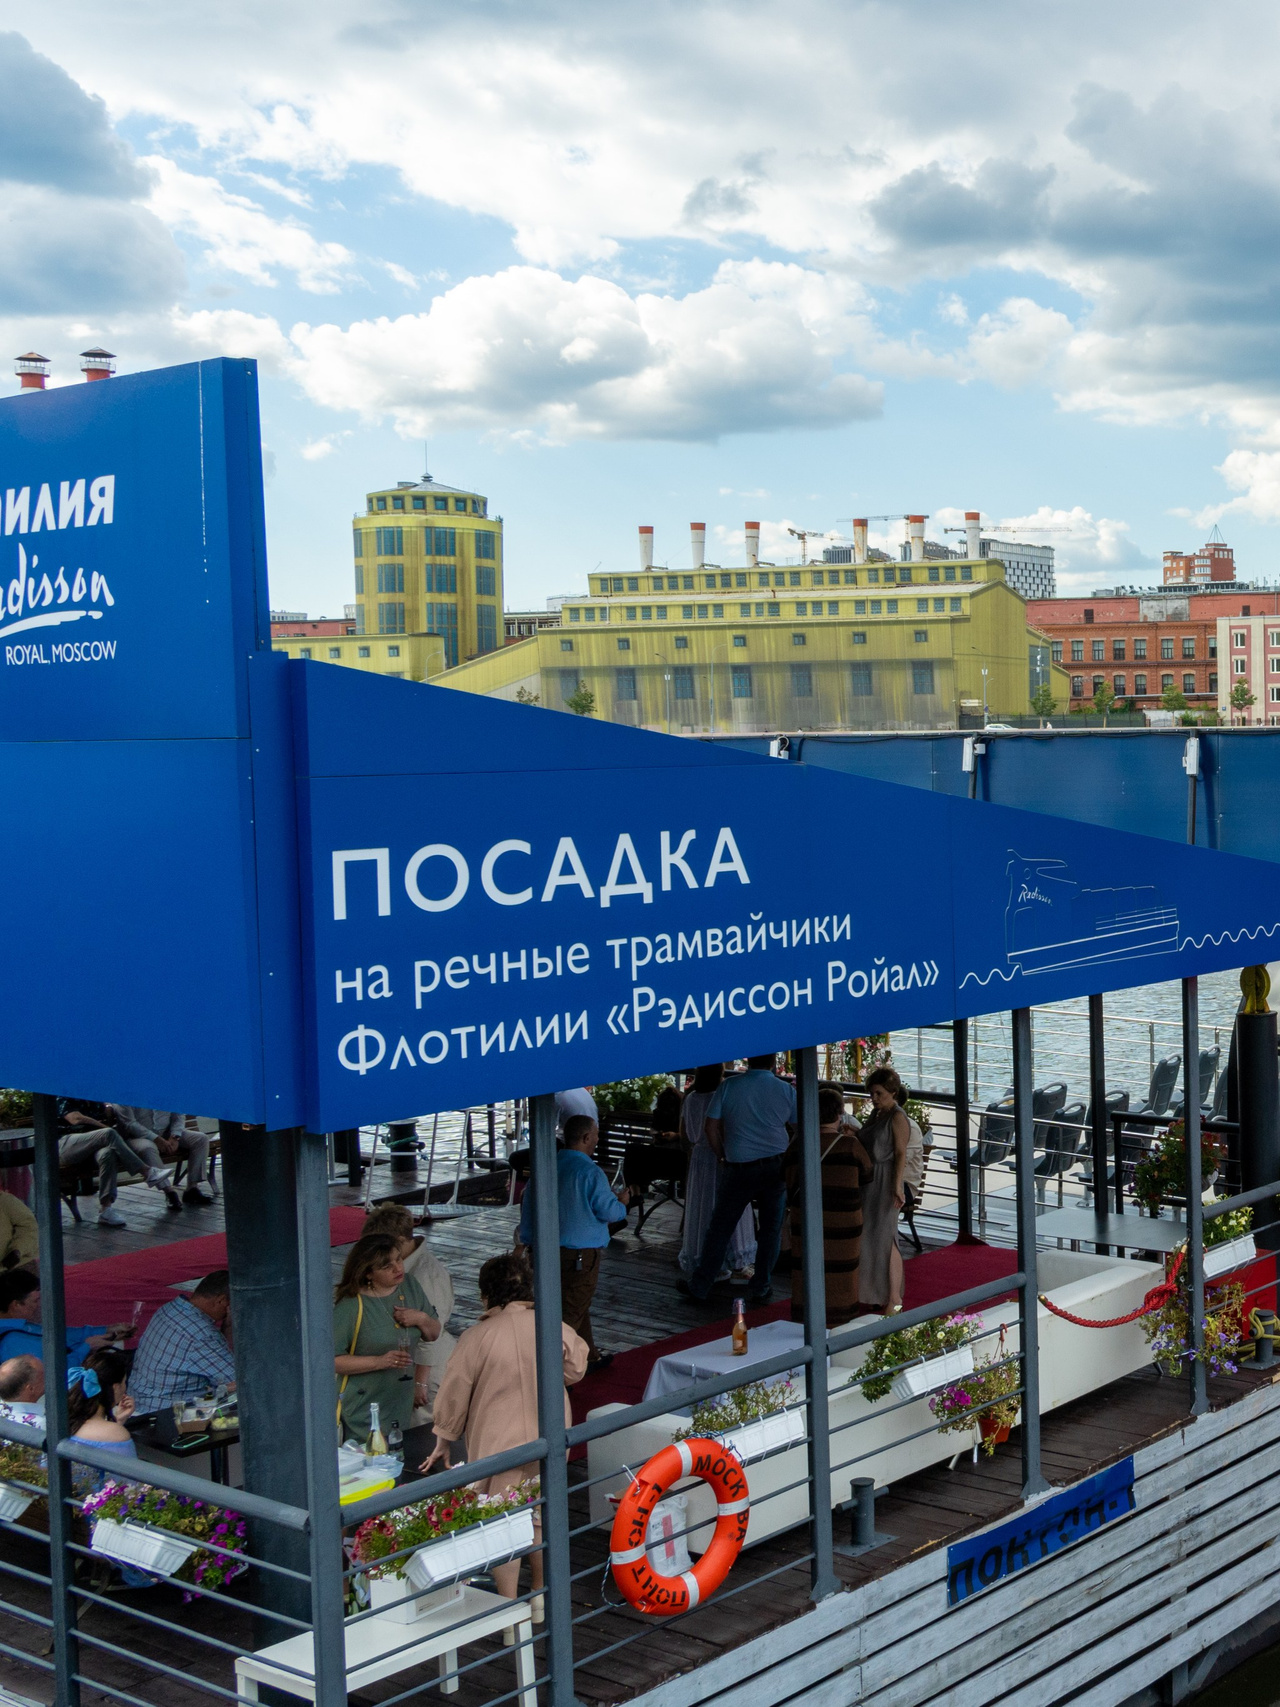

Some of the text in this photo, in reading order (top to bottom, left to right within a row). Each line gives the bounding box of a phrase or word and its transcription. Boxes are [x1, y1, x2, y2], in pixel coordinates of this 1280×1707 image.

[0, 474, 115, 536] ИЛИЯ
[0, 542, 115, 621] disson
[52, 640, 117, 664] MOSCOW
[332, 827, 751, 921] ПОСАДКА
[335, 911, 851, 1010] на речные трамвайчики
[337, 956, 940, 1076] Флотилии «Рэдиссон Ройал»
